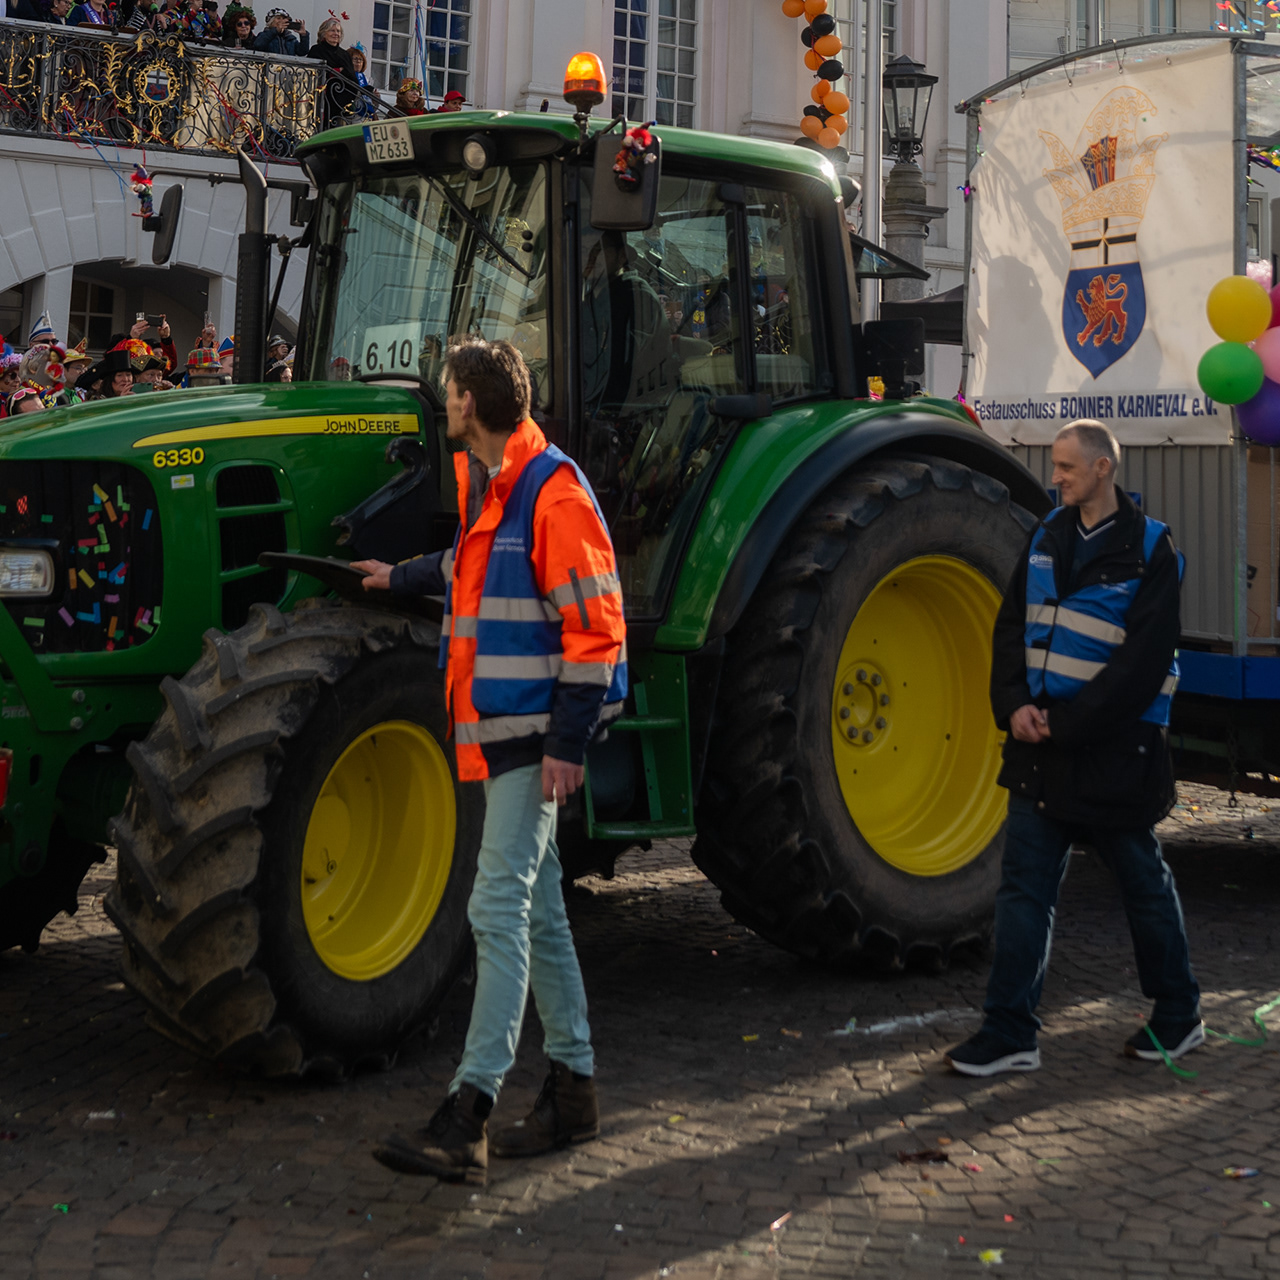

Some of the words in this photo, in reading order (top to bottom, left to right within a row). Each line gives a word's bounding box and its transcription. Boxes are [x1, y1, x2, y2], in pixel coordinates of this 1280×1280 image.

[372, 125, 388, 142] EU
[370, 144, 386, 160] MZ
[387, 141, 409, 159] 633
[974, 398, 1056, 421] Festausschuss
[1060, 396, 1114, 419] BONNER
[1117, 393, 1188, 418] KARNEVAL
[1192, 394, 1218, 417] e.V.
[323, 418, 356, 432] JOHN
[358, 418, 401, 432] DEERE
[152, 446, 205, 469] 6330
